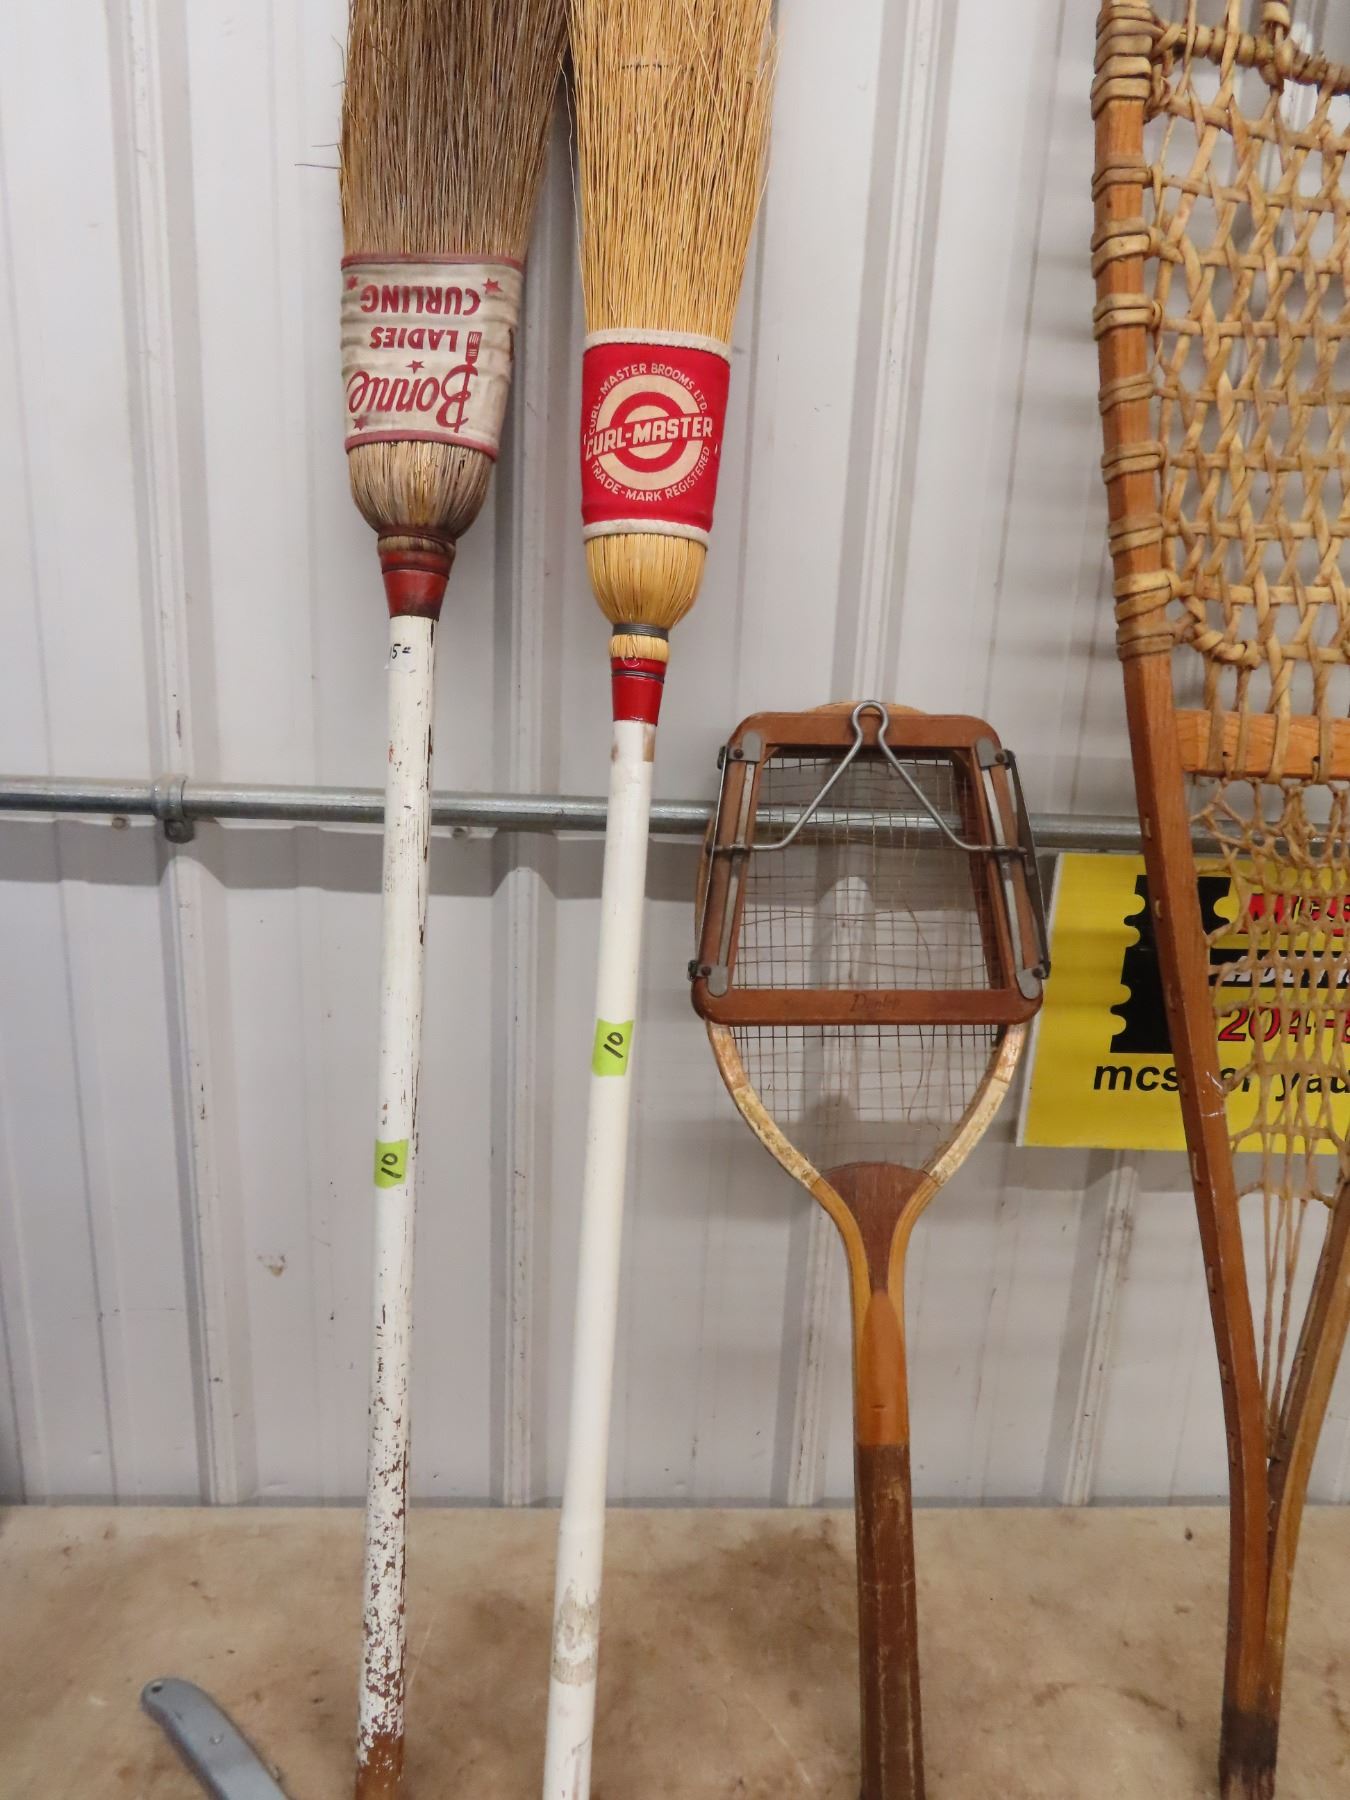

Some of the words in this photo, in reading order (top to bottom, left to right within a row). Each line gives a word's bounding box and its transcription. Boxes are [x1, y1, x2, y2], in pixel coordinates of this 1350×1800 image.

[360, 285, 481, 316] CURLING
[369, 326, 459, 352] LADIES
[651, 363, 695, 389] BROOMS
[346, 363, 479, 433] Bonnie
[585, 416, 713, 461] CURL-MASTER
[591, 459, 662, 502] TRADE-MARK
[665, 446, 710, 500] REGISTERED
[603, 1031, 624, 1059] 10
[380, 1152, 402, 1179] 10
